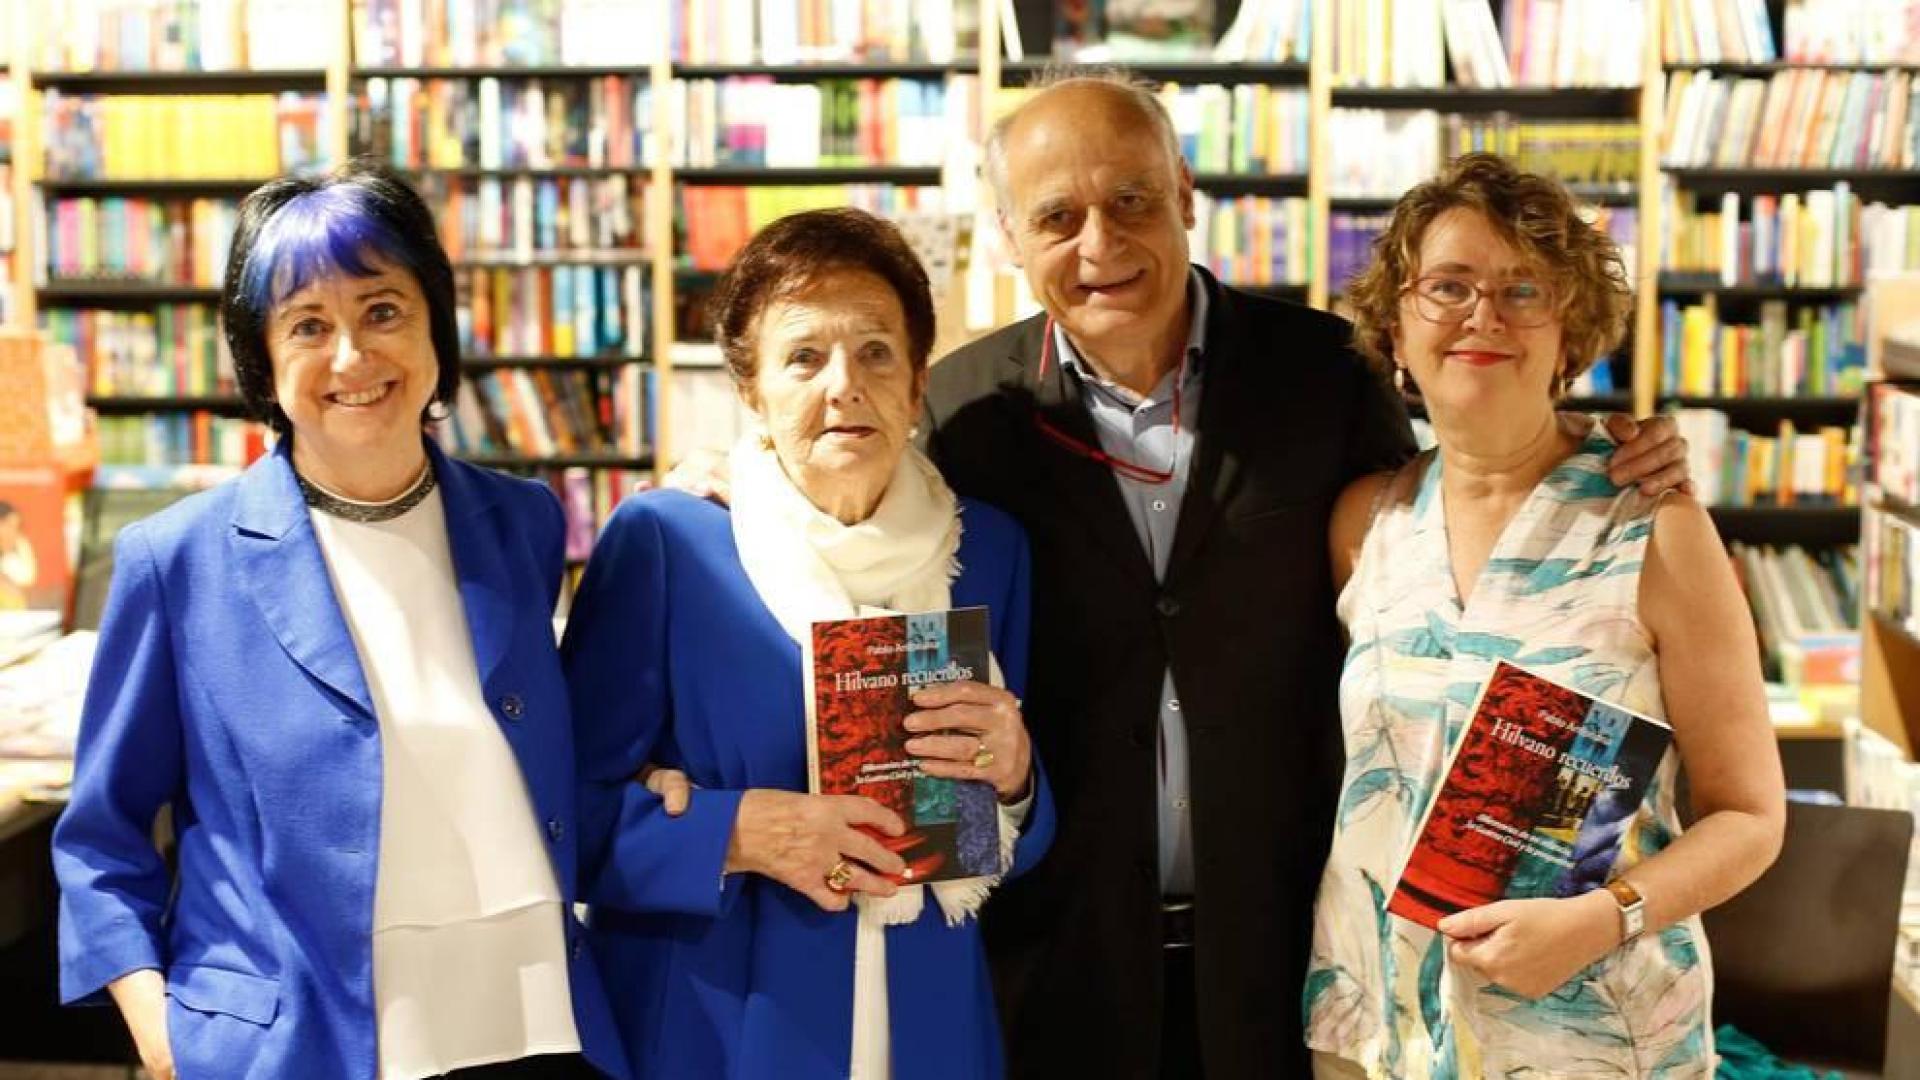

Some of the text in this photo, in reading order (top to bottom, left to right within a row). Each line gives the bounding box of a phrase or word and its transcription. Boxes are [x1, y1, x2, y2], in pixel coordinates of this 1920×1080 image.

[835, 670, 899, 692] Hilvano
[1489, 717, 1557, 759] Hilvano
[1558, 751, 1632, 789] recuerdos
